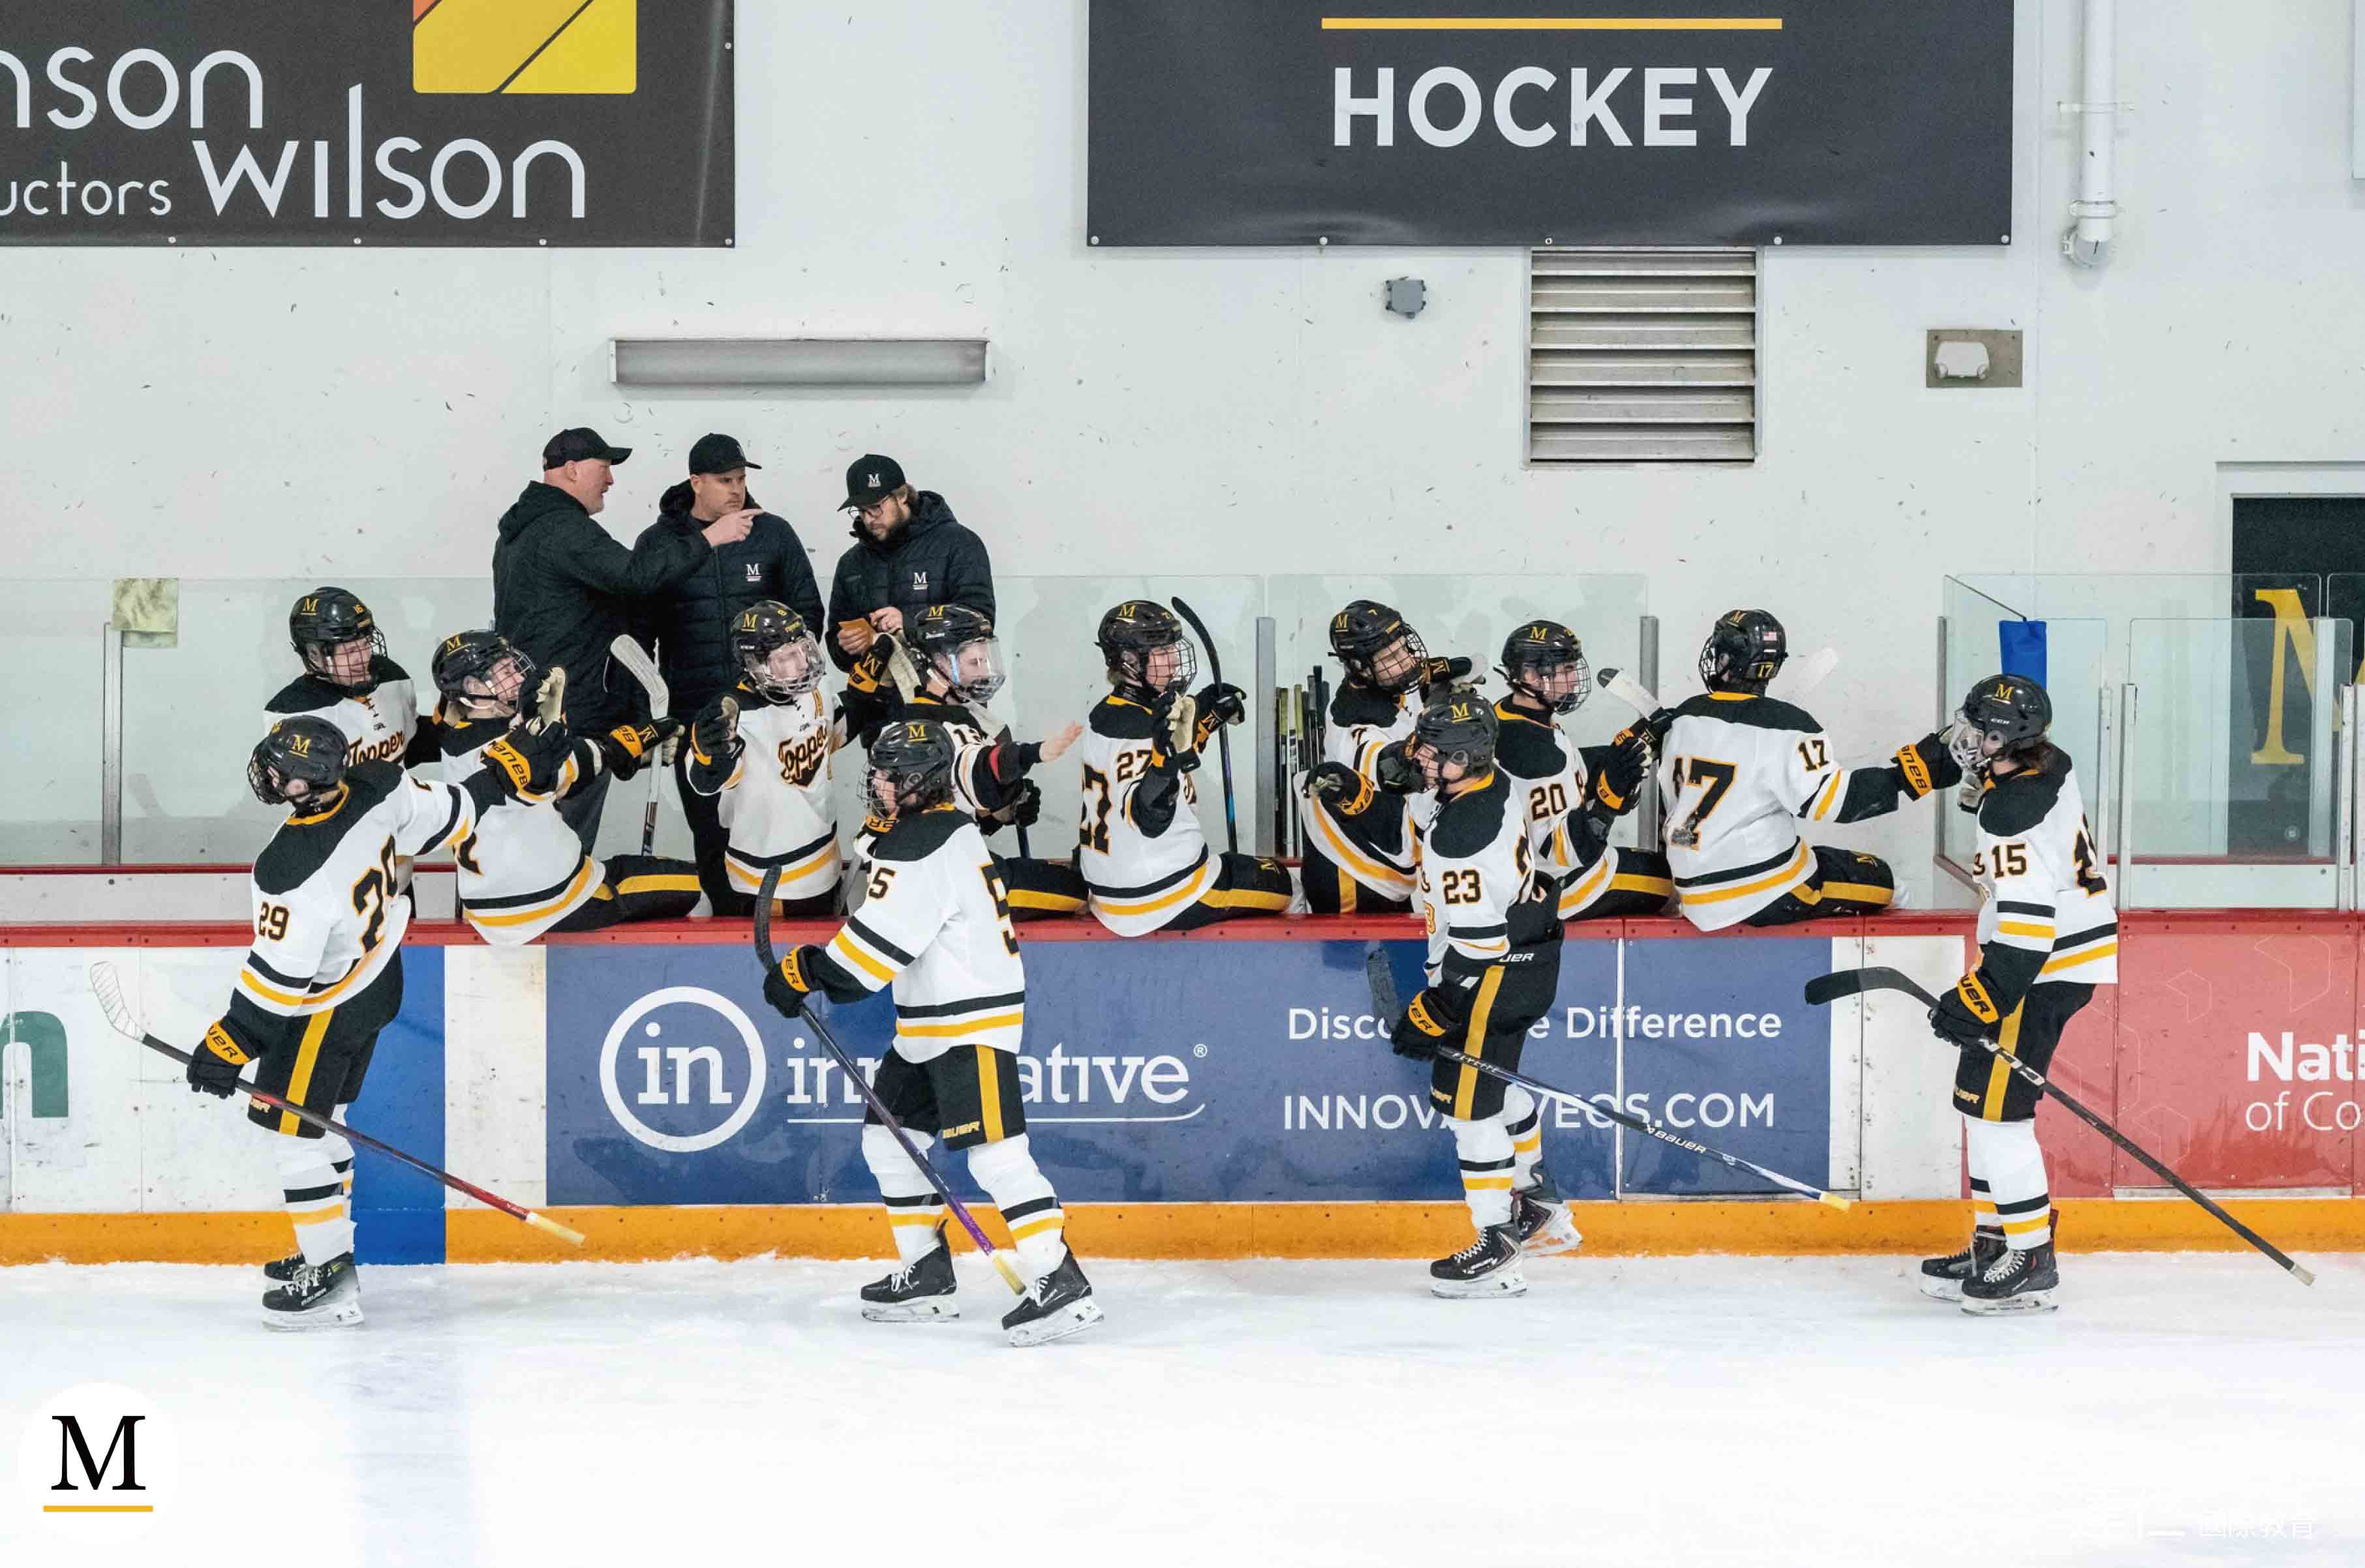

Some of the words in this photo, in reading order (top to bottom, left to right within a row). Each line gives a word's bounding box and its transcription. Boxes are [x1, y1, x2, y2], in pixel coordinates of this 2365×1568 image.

[1334, 67, 1773, 147] HOCKEY
[192, 83, 585, 219] wilson
[746, 564, 759, 576] M
[913, 571, 927, 584] M
[303, 598, 319, 612] M
[929, 606, 945, 617] M
[1118, 604, 1137, 618] M
[742, 614, 758, 628] M
[1335, 614, 1348, 629] M
[1529, 626, 1548, 641] M
[446, 636, 461, 652] M
[1758, 664, 1774, 678] 17
[1994, 683, 2015, 700] M
[1451, 702, 1469, 718] M
[908, 725, 925, 738] M
[292, 734, 311, 753] M
[1797, 740, 1829, 772] 17
[1116, 749, 1153, 784] 27
[1530, 783, 1567, 821] 20
[1992, 842, 2028, 879] 15
[868, 866, 896, 899] 5
[1442, 869, 1482, 905] 23
[258, 901, 290, 941] 29
[638, 1022, 732, 1104] in
[787, 1038, 1190, 1104] inative
[2246, 1091, 2291, 1132] of
